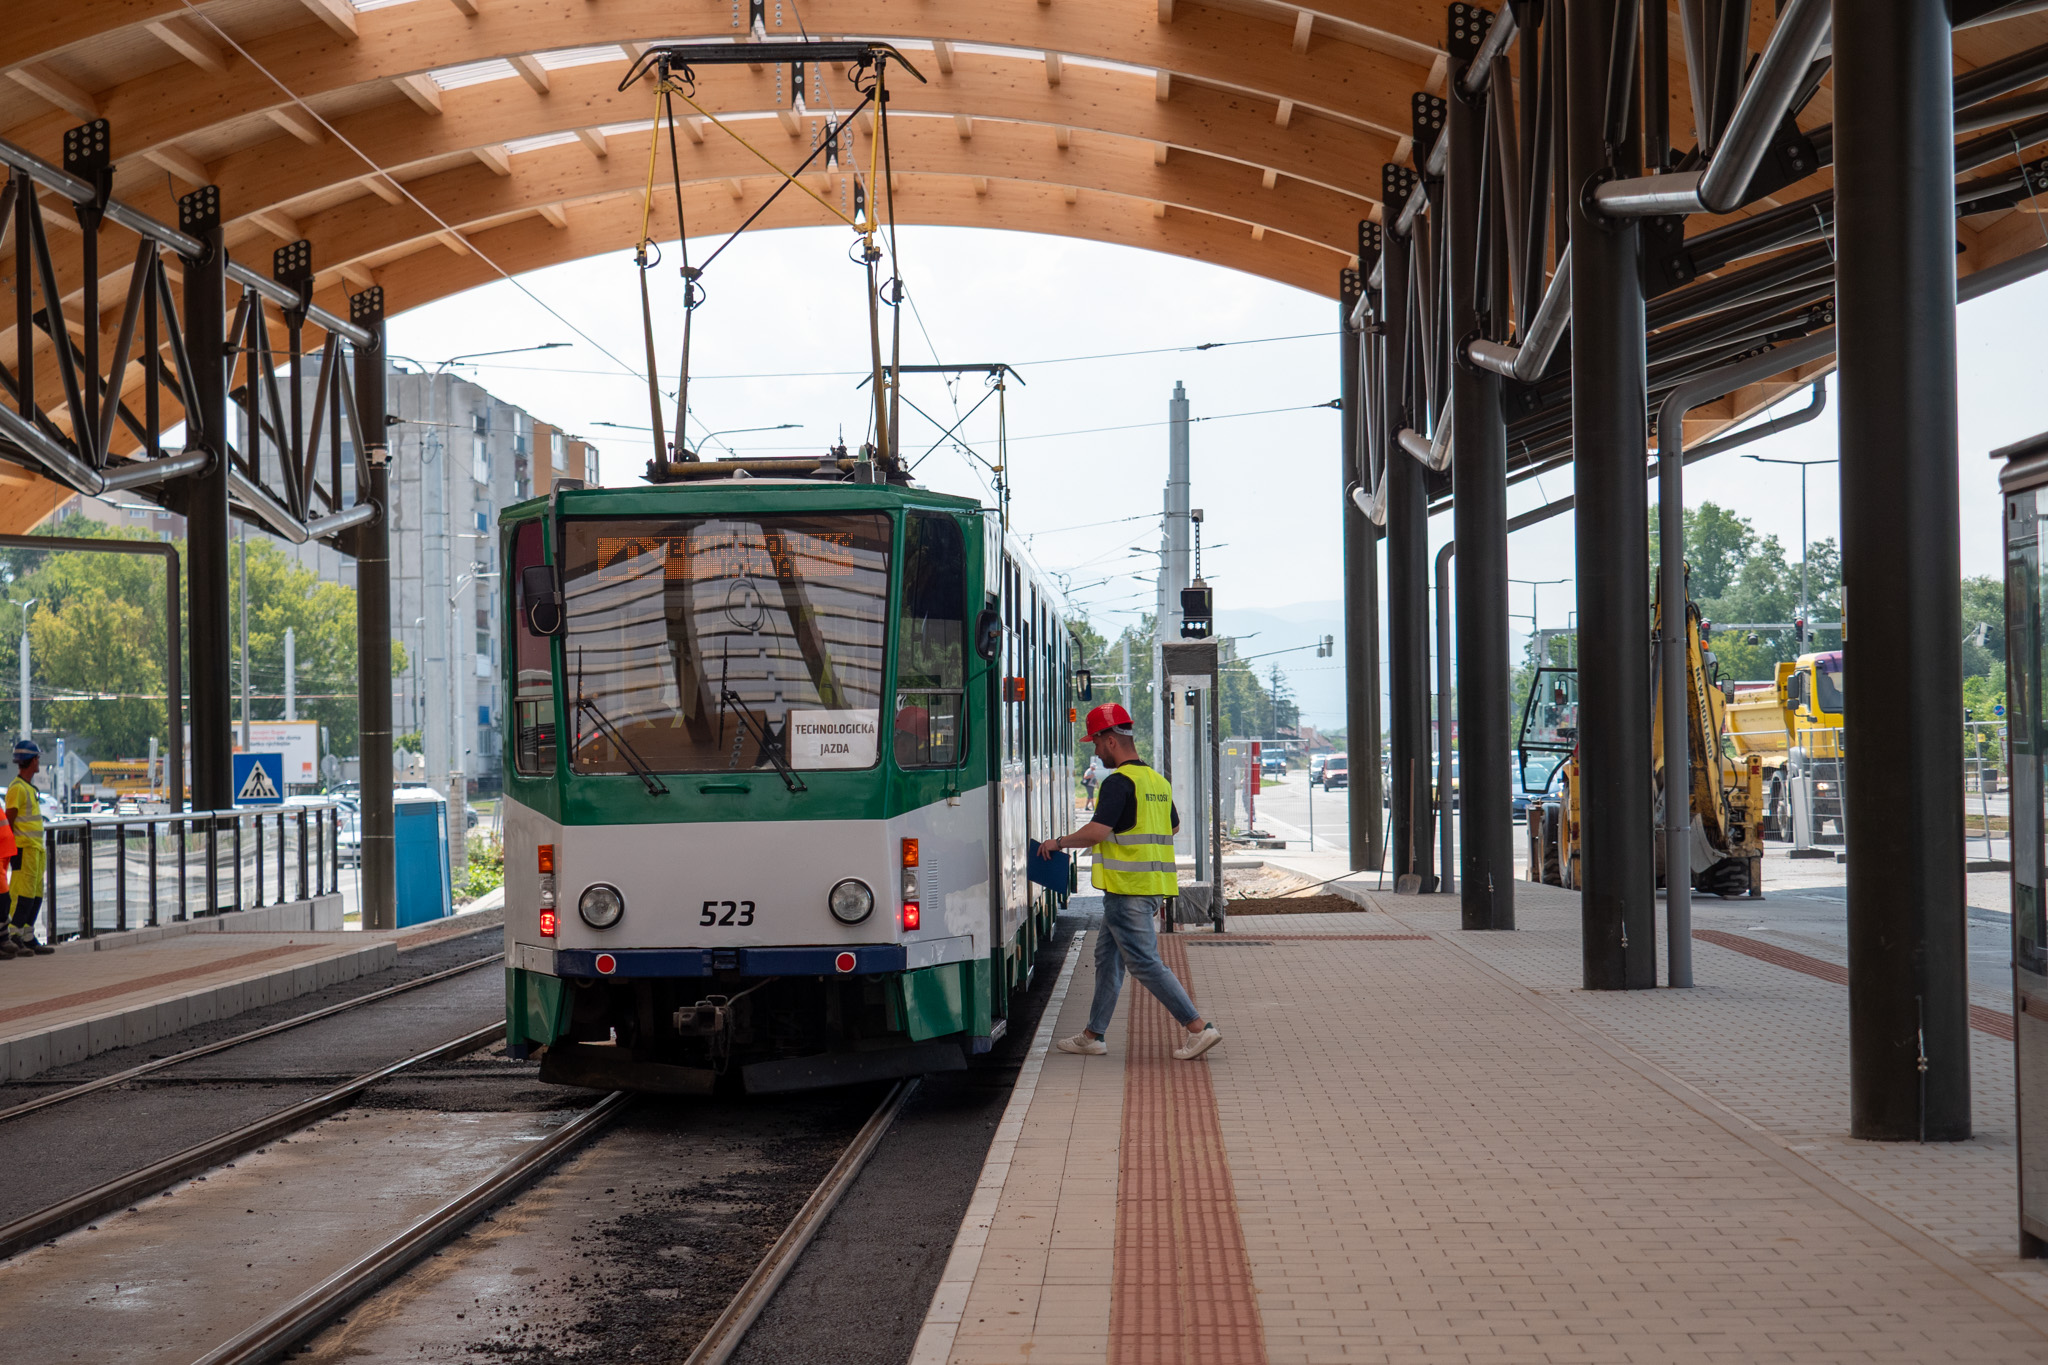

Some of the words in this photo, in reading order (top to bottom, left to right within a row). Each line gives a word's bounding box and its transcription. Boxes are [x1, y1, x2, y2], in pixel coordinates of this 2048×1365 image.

[719, 557, 795, 578] JAZDA
[795, 721, 875, 735] TECHNOLOGICKÁ
[1701, 699, 1712, 759] HOLLAND
[820, 743, 850, 756] JAZDA
[699, 901, 756, 927] 523
